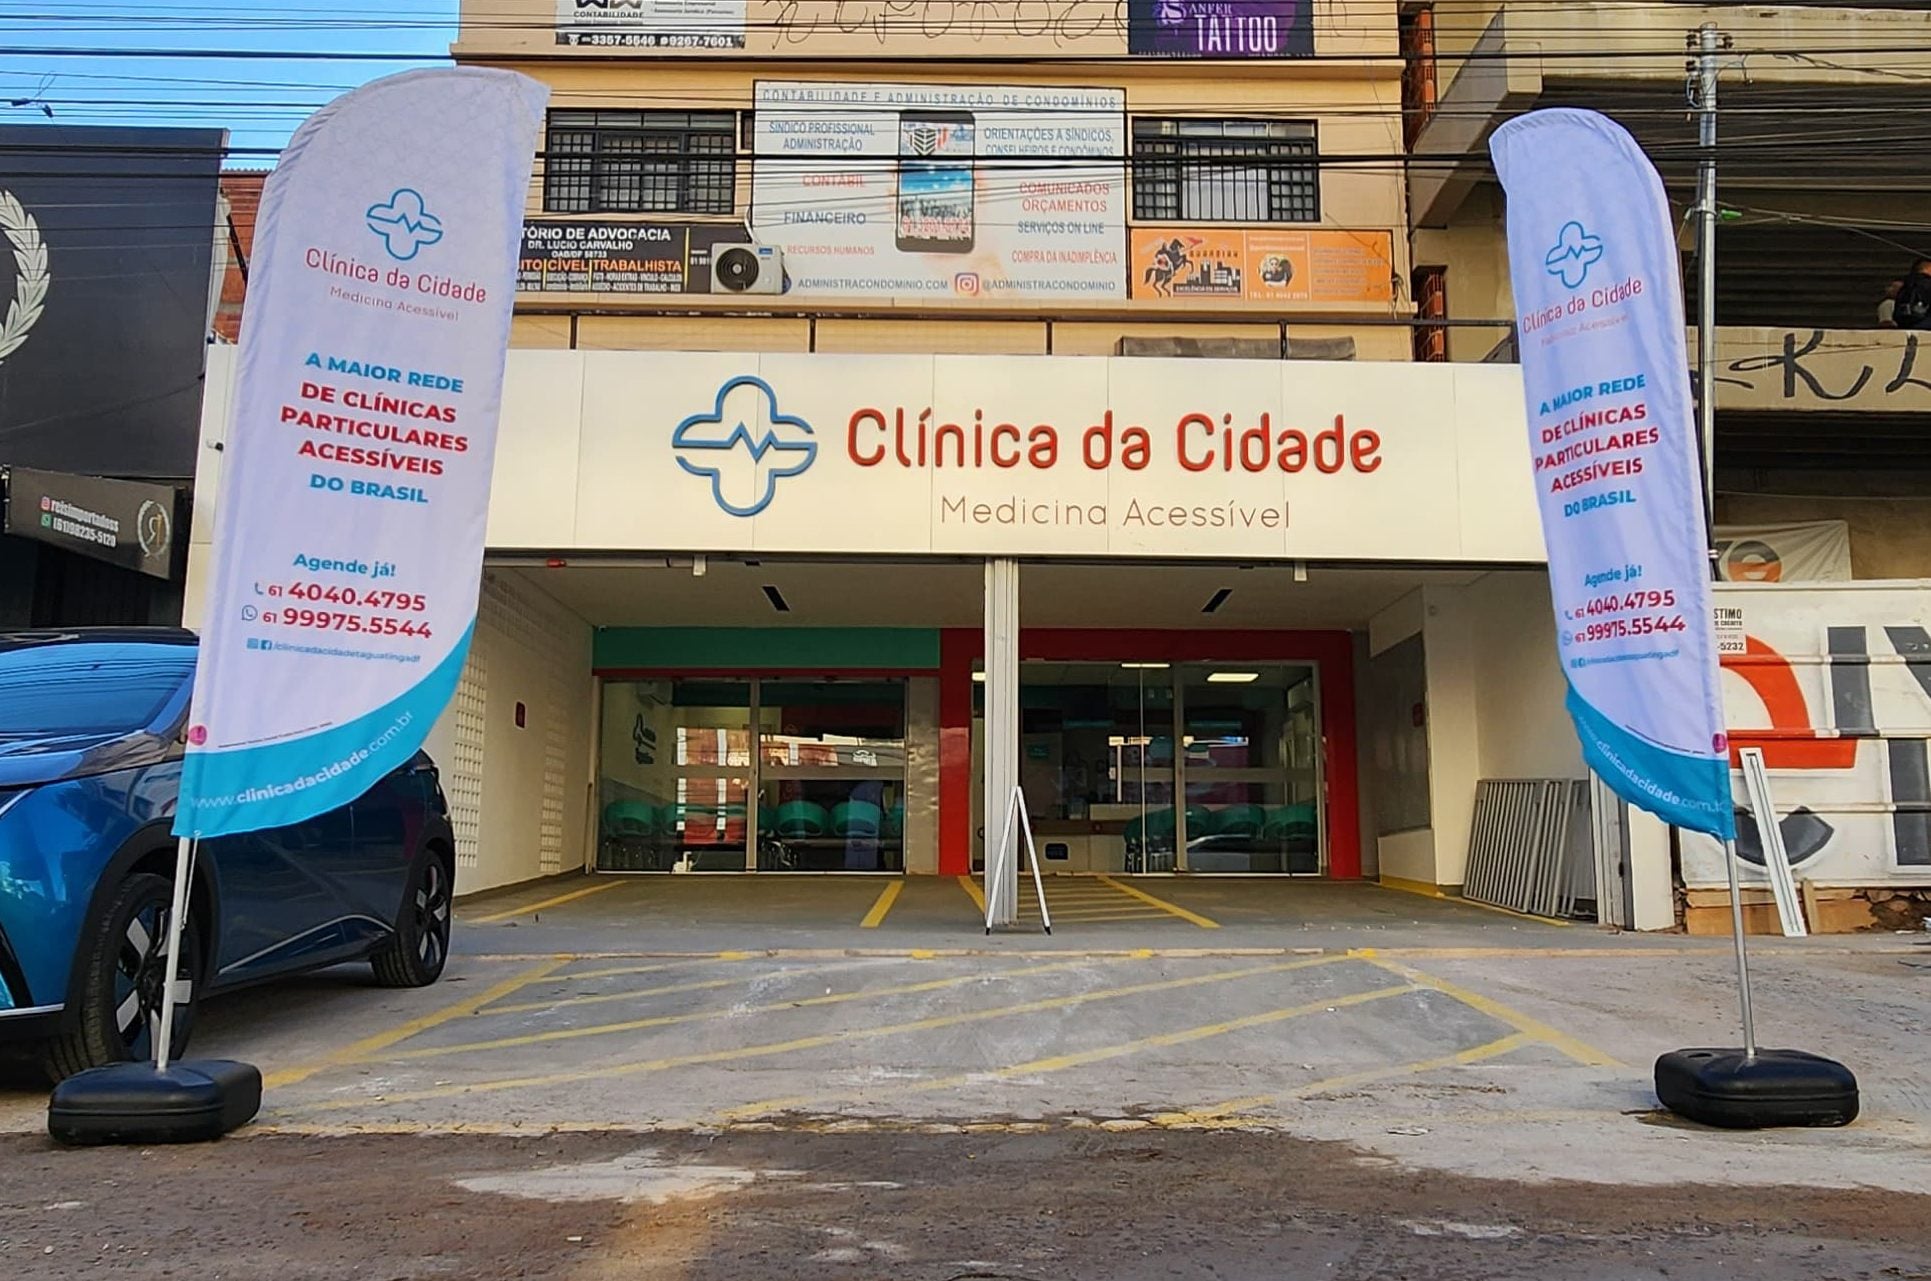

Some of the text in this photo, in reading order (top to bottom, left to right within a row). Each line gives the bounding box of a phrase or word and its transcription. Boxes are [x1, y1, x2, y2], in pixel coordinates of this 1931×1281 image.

[1195, 15, 1277, 52] TATTOO
[762, 89, 1117, 108] CONTABILIDADE E ADMINISTRAÇÃO DE CONDOMÍNIOS
[769, 120, 875, 136] SÍNDICO PROFISSIONAL
[984, 127, 1054, 142] ORIENTAÇÕES
[783, 137, 863, 153] ADMINISTRAÇÃO
[803, 174, 864, 188] CONTÁBIL
[1019, 182, 1110, 195] COMUNICADOS
[784, 211, 866, 225] FINANCEIRO
[1022, 199, 1107, 213] ORÇAMENTOS
[566, 227, 585, 240] DE
[588, 228, 671, 241] ADVOCACIA
[1017, 221, 1105, 236] SERVIÇOS ON LINE
[579, 241, 634, 250] CARVALHO
[787, 245, 875, 256] RECURSOS HUMANOS
[1011, 250, 1045, 263] COMPRA
[1046, 251, 1056, 263] DA
[305, 247, 379, 283] Clínica
[386, 267, 410, 290] da
[417, 273, 487, 304] Cidade
[592, 259, 682, 272] TRABALHISTA
[798, 278, 949, 290] ADMINISTRACONDOMINIO.COM
[983, 279, 1116, 292] @ADMINISTRACONDOMINIO
[329, 286, 459, 321] Medicina Acessível
[1522, 276, 1642, 335] Clínica da Cidade
[305, 352, 465, 394] A MAIOR REDE
[301, 381, 457, 424] DE CLÍNICAS
[1540, 373, 1646, 416] A MAIOR REDE
[280, 405, 469, 452] PARTICULARES
[1542, 403, 1646, 444] DE CLÍNICAS
[847, 406, 1383, 475] Clínica da Cidade
[1535, 426, 1659, 473] PARTICULARES
[298, 439, 444, 476] ACESSÍVEIS
[310, 473, 429, 503] DO BRASIL
[1551, 457, 1643, 493] ACESSÍVEIS
[940, 496, 1291, 531] Medicina Acessível
[1564, 489, 1637, 518] DO BRASIL
[292, 552, 396, 579] Agende já!
[1584, 565, 1643, 588] Agende já!
[268, 581, 427, 612] 61 4040.4795
[1575, 589, 1675, 618] 61 4040.4795
[262, 607, 433, 639] 61 99975.5544
[1575, 614, 1686, 643] 61 99975.5544
[191, 710, 414, 809] www.clinicadacidade.com.br
